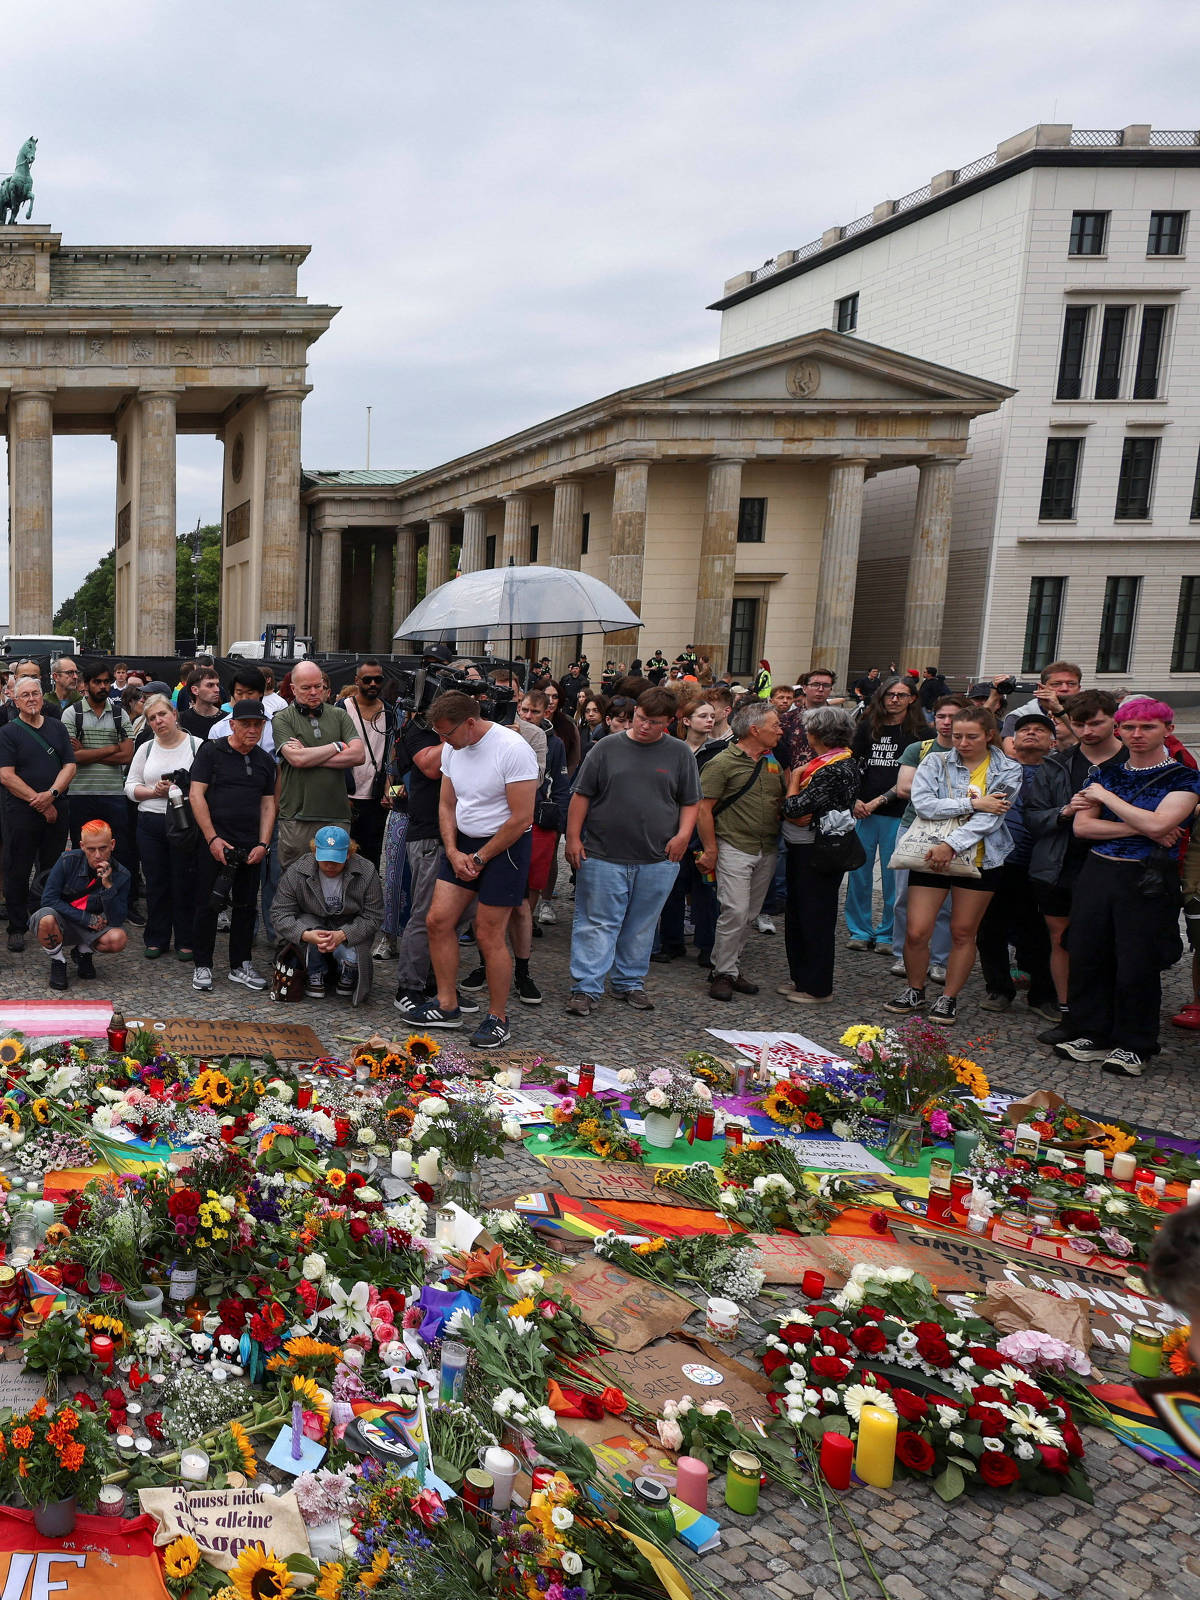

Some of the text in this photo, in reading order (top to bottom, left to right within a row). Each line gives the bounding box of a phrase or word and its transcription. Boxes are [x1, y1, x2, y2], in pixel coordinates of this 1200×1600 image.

[871, 743, 898, 752] SHOULD
[880, 736, 892, 744] WE
[867, 758, 899, 767] FEMINISTS
[871, 751, 895, 759] ALL BE
[163, 1020, 300, 1036] HATE IS LOV
[204, 1034, 312, 1048] POWERFUL
[280, 1048, 315, 1057] THE
[552, 1158, 656, 1179] OUR GRIE
[570, 1172, 600, 1185] IS
[598, 1174, 647, 1190] NOT
[908, 1234, 1123, 1290] WIDESTAND
[602, 1355, 667, 1376] RAGE
[630, 1375, 683, 1400] GRIEF
[189, 1493, 230, 1509] musst
[215, 1511, 273, 1529] alleine
